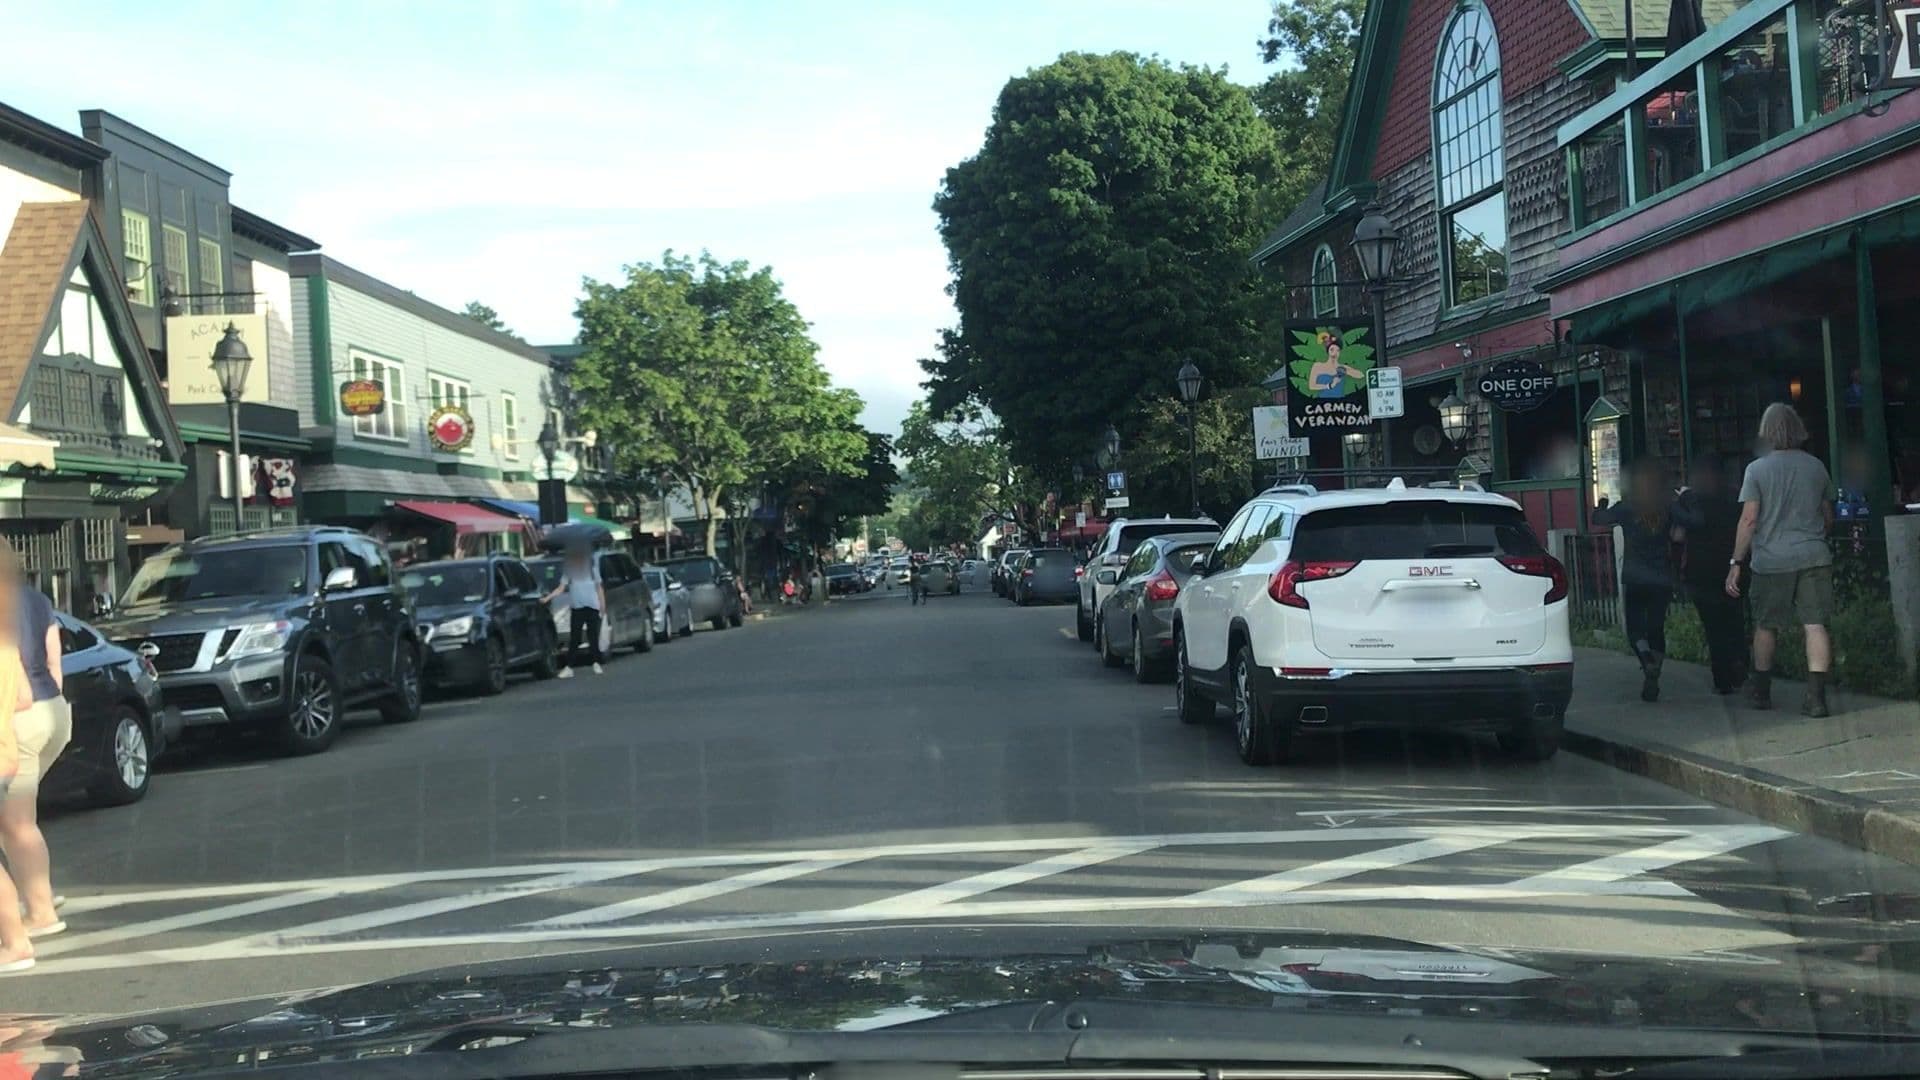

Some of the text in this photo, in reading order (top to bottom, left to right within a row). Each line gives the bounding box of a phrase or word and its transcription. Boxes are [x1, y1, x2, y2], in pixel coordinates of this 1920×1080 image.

[1370, 374, 1378, 385] 2
[1481, 377, 1553, 393] ONE OFF
[1505, 391, 1532, 399] PUB
[1305, 402, 1362, 415] CARMEN
[1295, 415, 1373, 429] VERANDAH
[1263, 444, 1303, 458] WINDS
[1409, 565, 1454, 577] GMC
